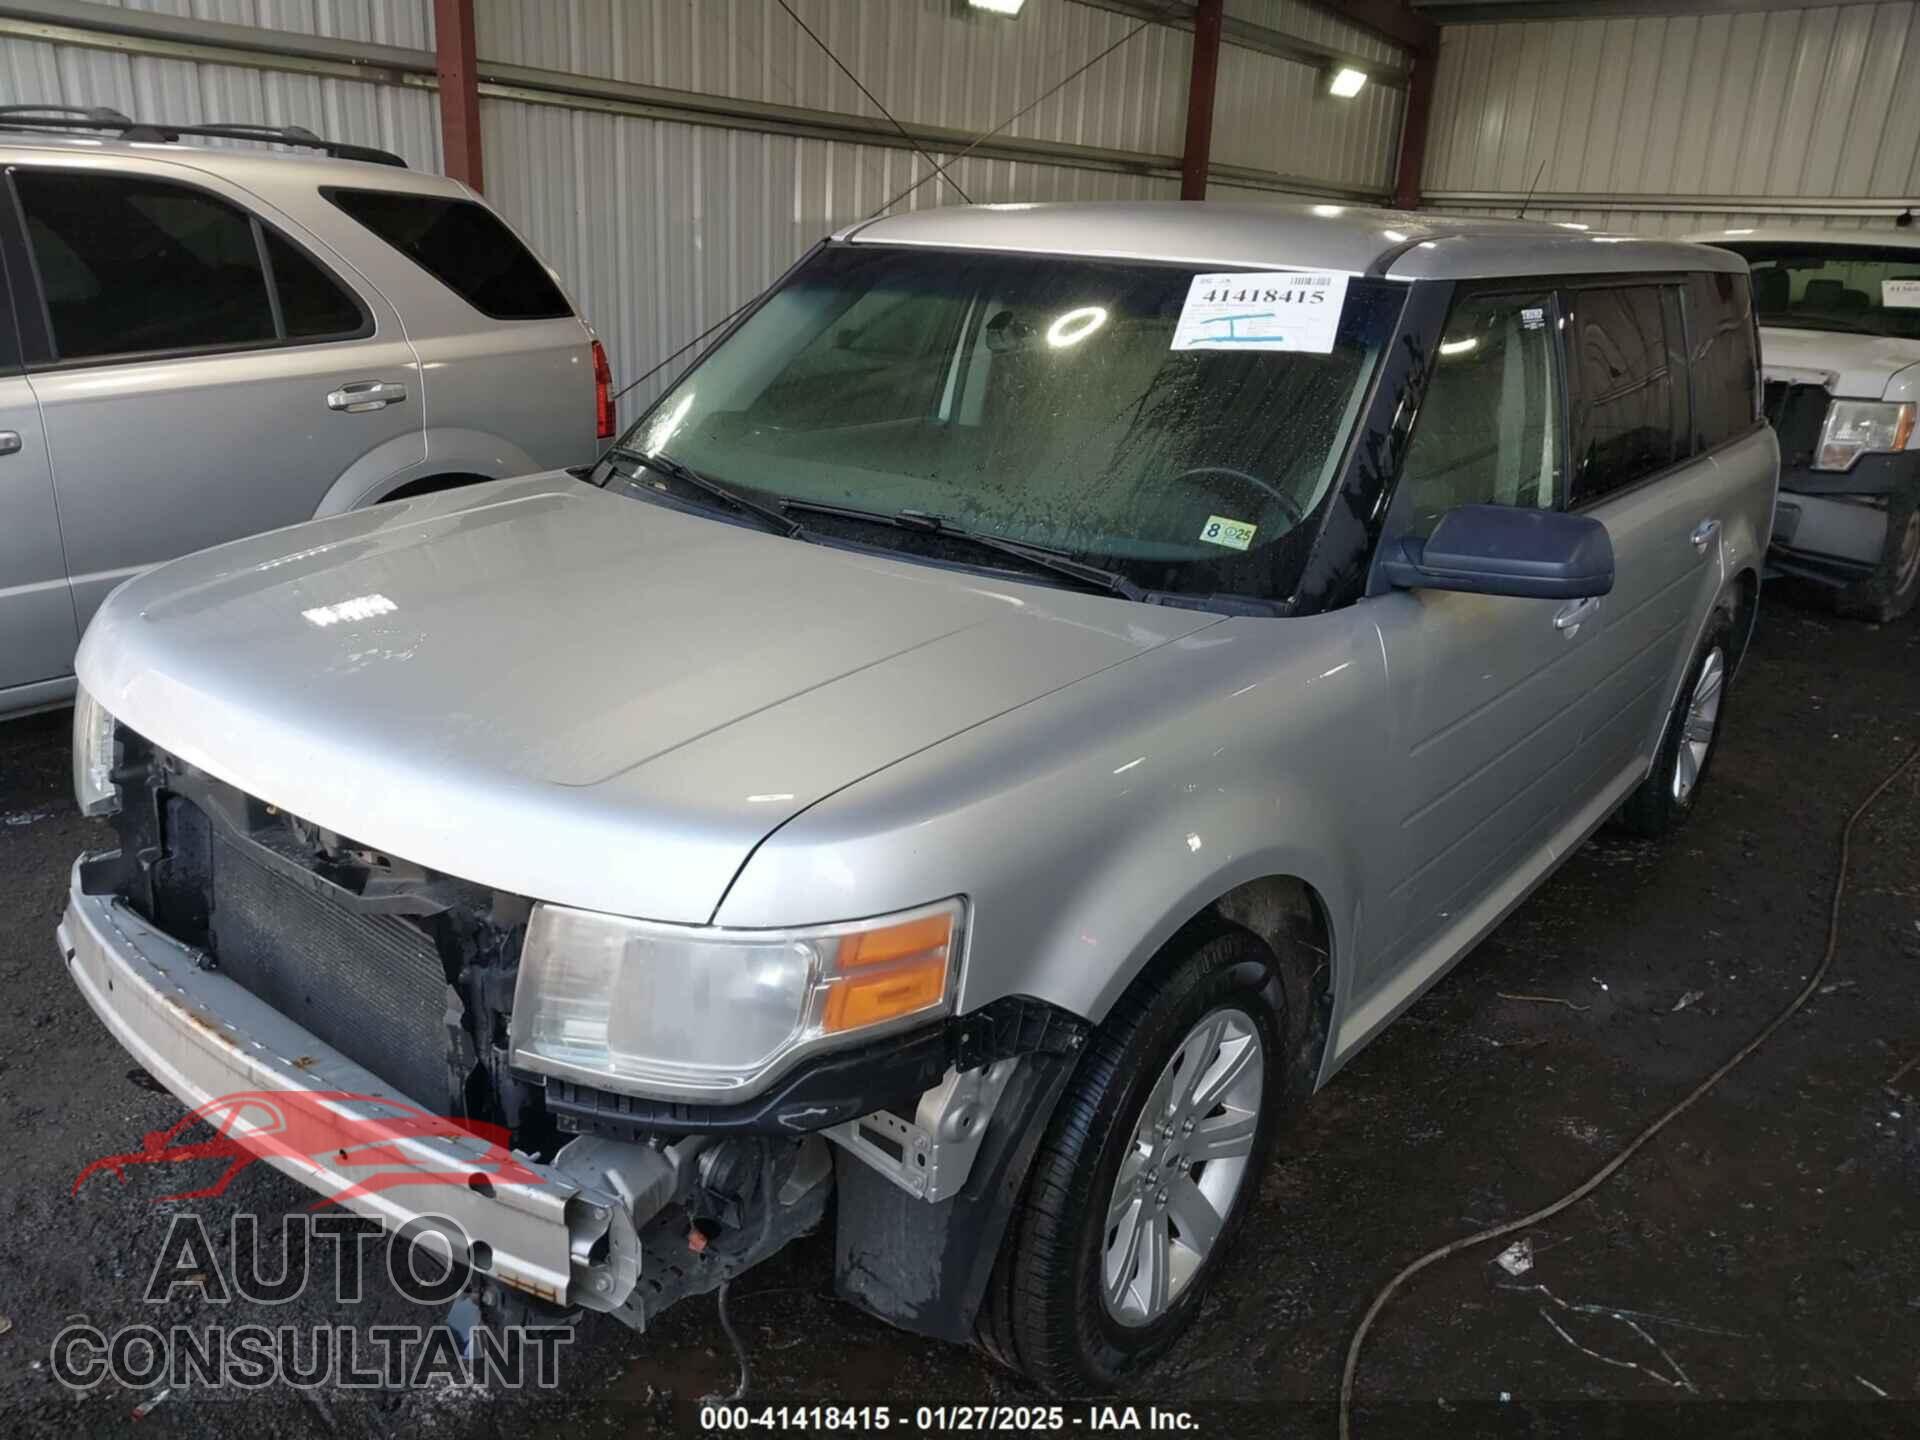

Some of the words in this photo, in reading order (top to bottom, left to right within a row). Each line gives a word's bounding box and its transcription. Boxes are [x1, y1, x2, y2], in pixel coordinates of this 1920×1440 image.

[1202, 288, 1327, 304] 41418415
[1207, 522, 1222, 538] 8
[1235, 528, 1253, 541] 25
